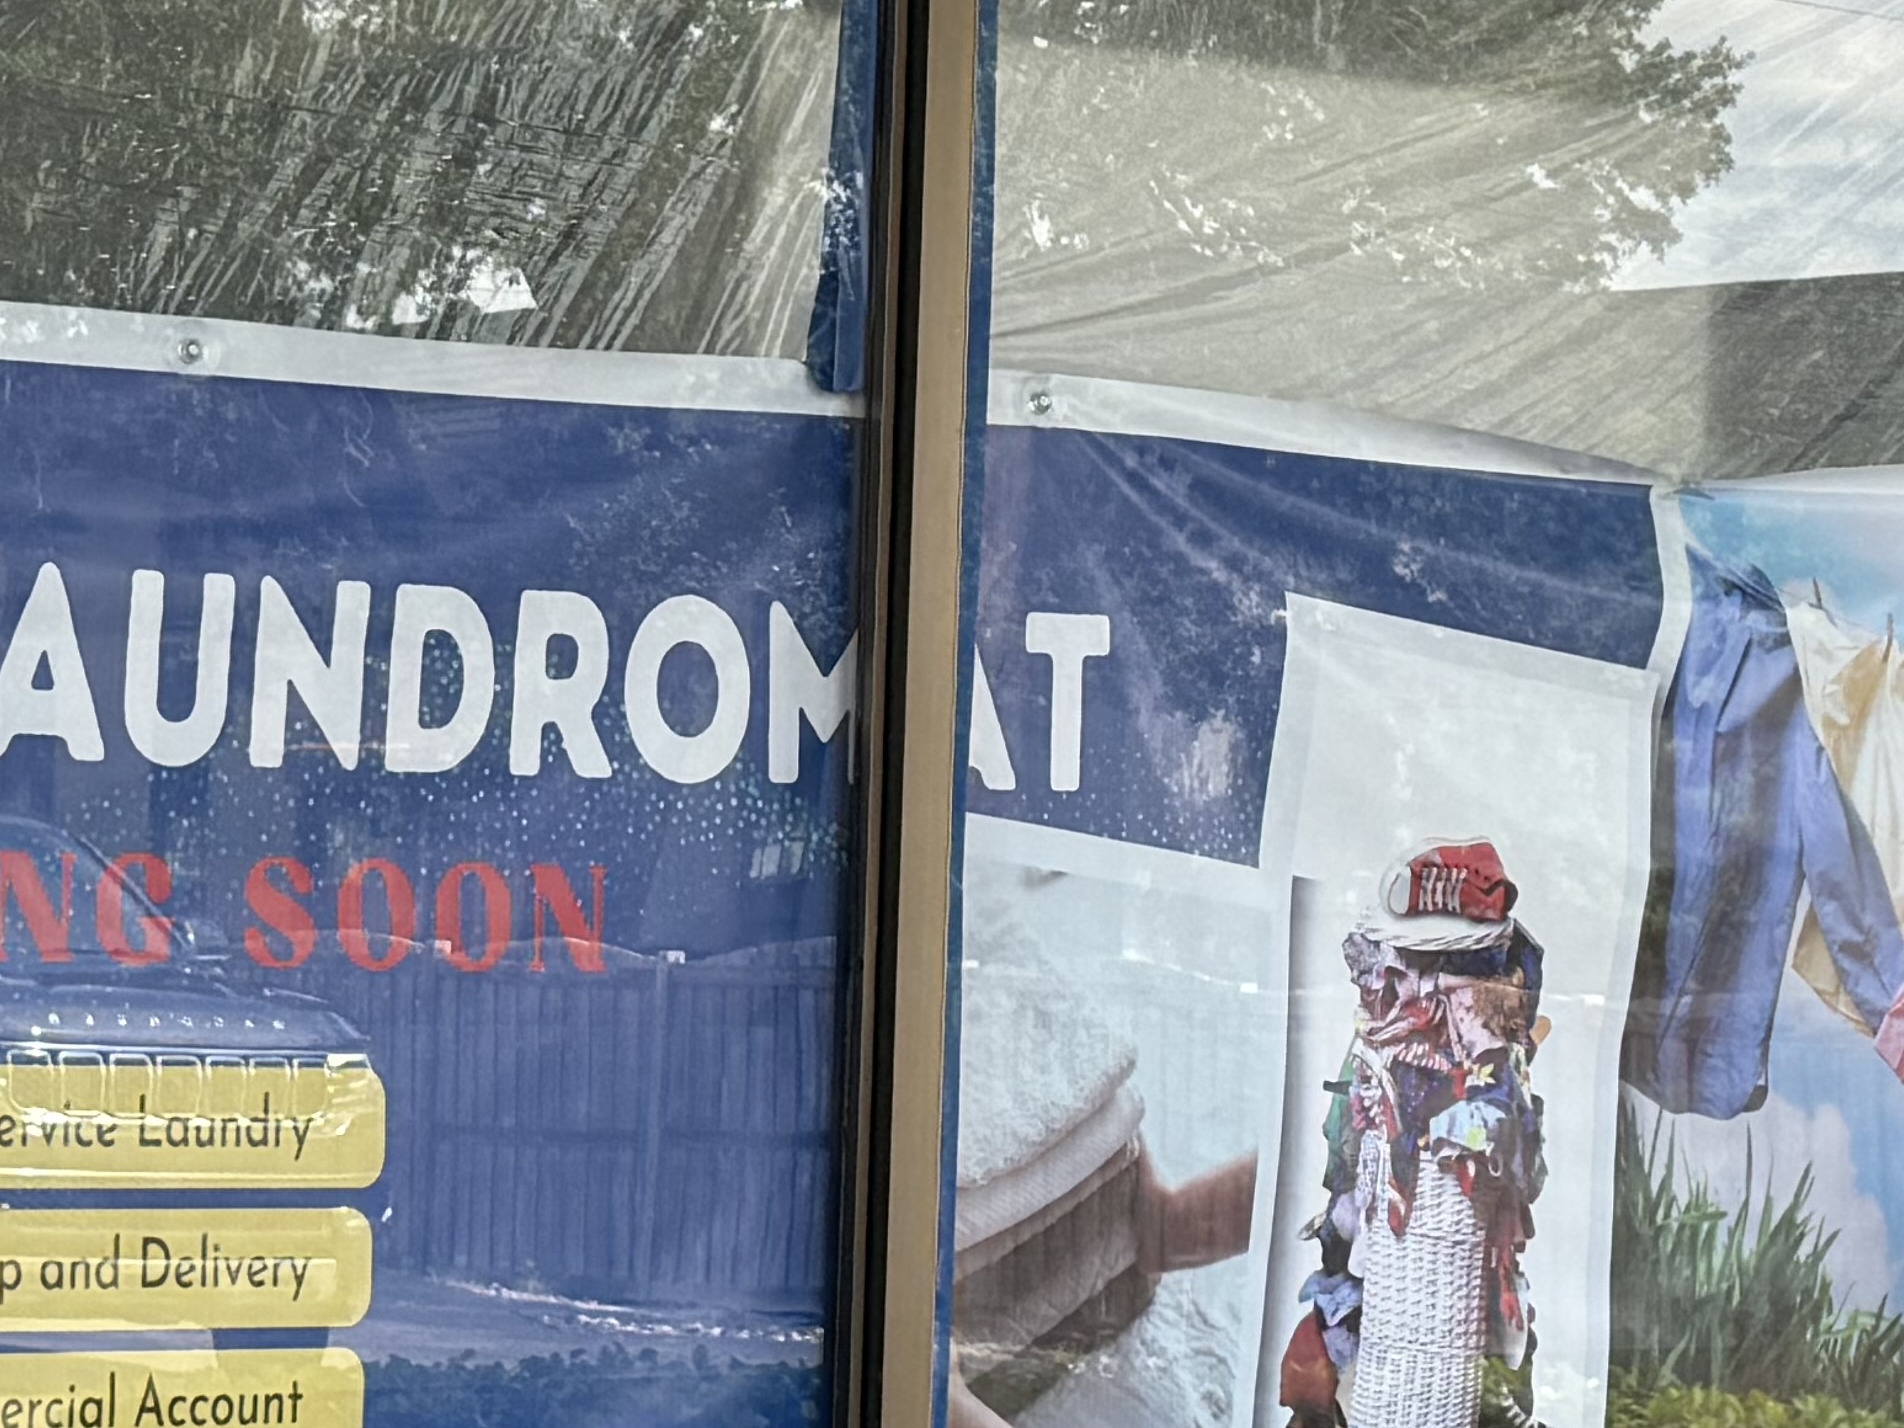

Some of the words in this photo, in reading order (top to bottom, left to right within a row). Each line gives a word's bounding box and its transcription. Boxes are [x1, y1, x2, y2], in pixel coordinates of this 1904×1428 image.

[243, 857, 607, 971] SOON
[138, 1092, 314, 1160] Laundry
[40, 1233, 121, 1290] and
[140, 1233, 312, 1301] Delivery
[134, 1373, 304, 1428] Account
